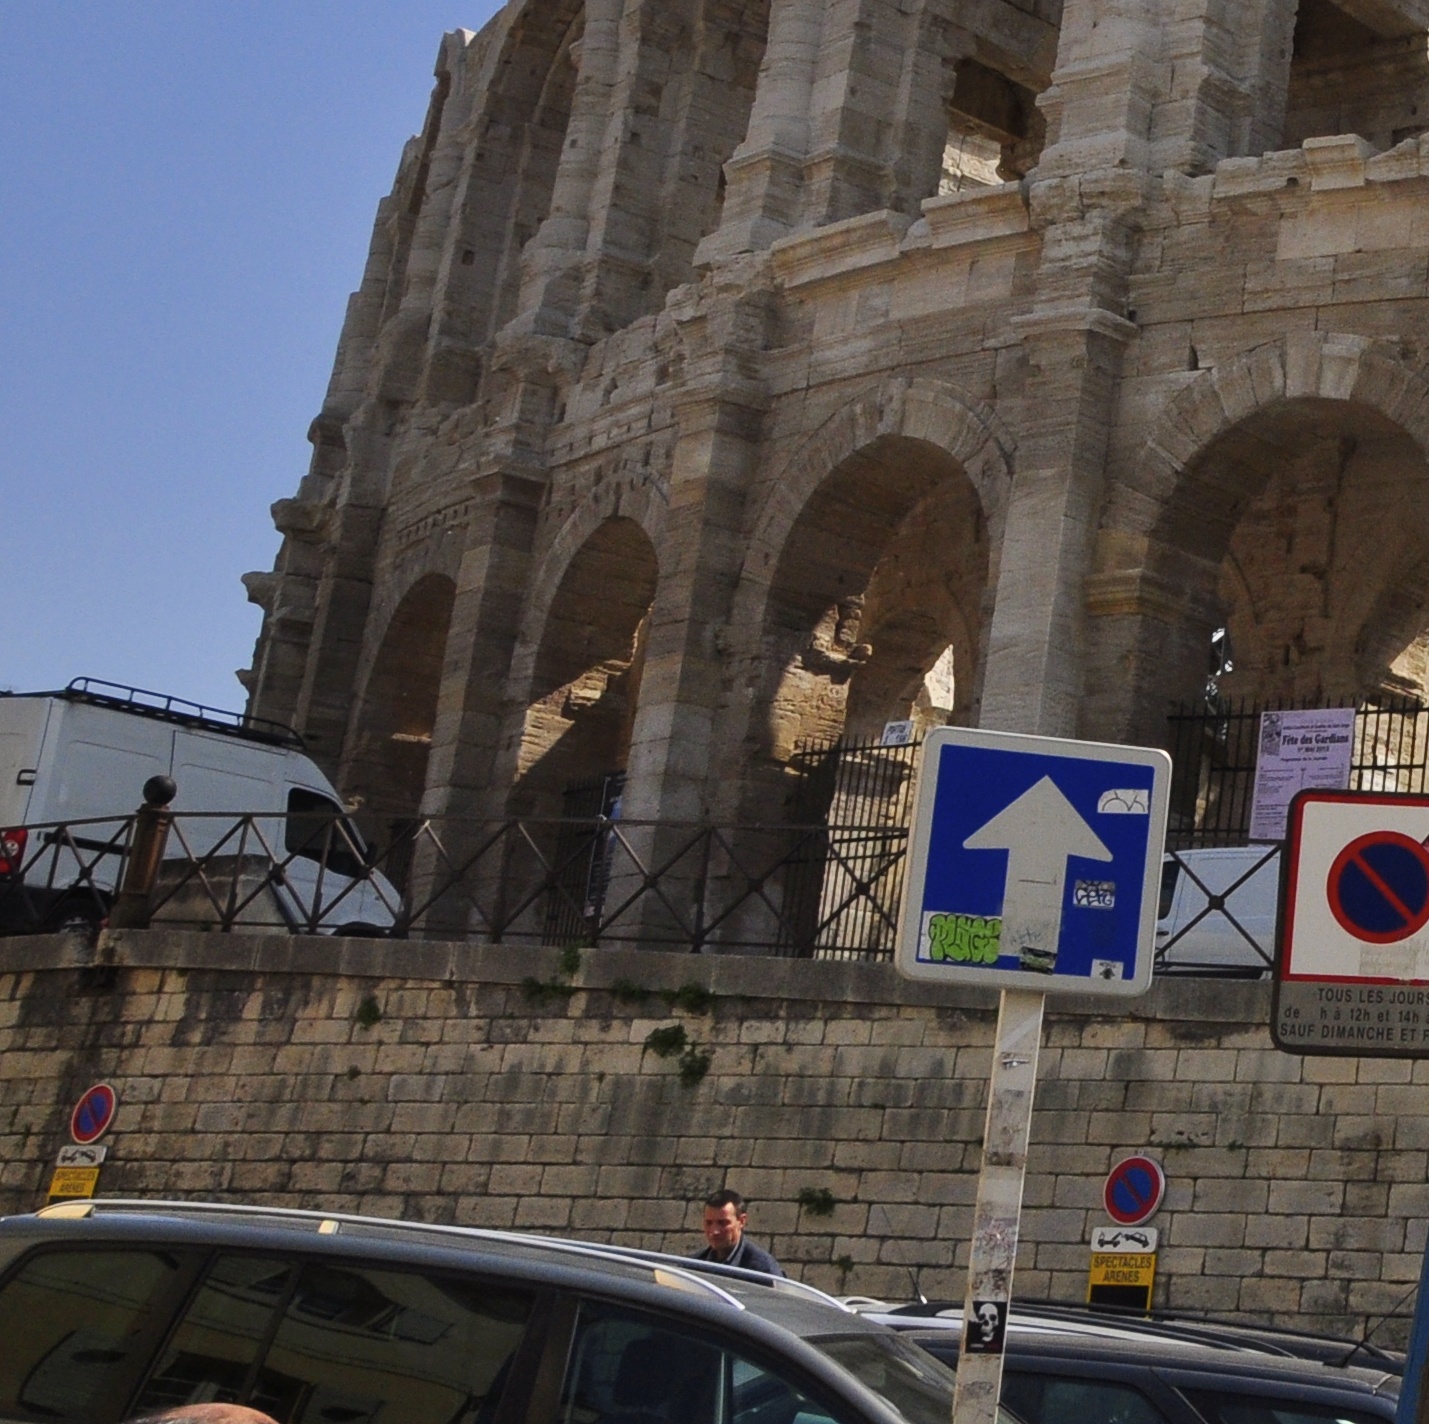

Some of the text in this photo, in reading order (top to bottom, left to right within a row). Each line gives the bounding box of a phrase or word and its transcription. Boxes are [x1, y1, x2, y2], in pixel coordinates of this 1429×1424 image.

[1282, 733, 1349, 745] Fête des Gardians
[1318, 988, 1352, 1003] TOUS
[1359, 989, 1383, 1004] LES
[1285, 1006, 1300, 1019] de
[1320, 1007, 1327, 1019] h
[1334, 1007, 1341, 1020] à
[1350, 1008, 1370, 1021] 12h
[1377, 1009, 1389, 1022] et
[1399, 1010, 1419, 1023] 14h
[1280, 1023, 1315, 1037] SAUF
[1322, 1024, 1394, 1041] DIMANCHE
[1401, 1028, 1416, 1042] ET
[1093, 1256, 1152, 1269] SPECTACLES
[1103, 1270, 1140, 1282] ARENES
